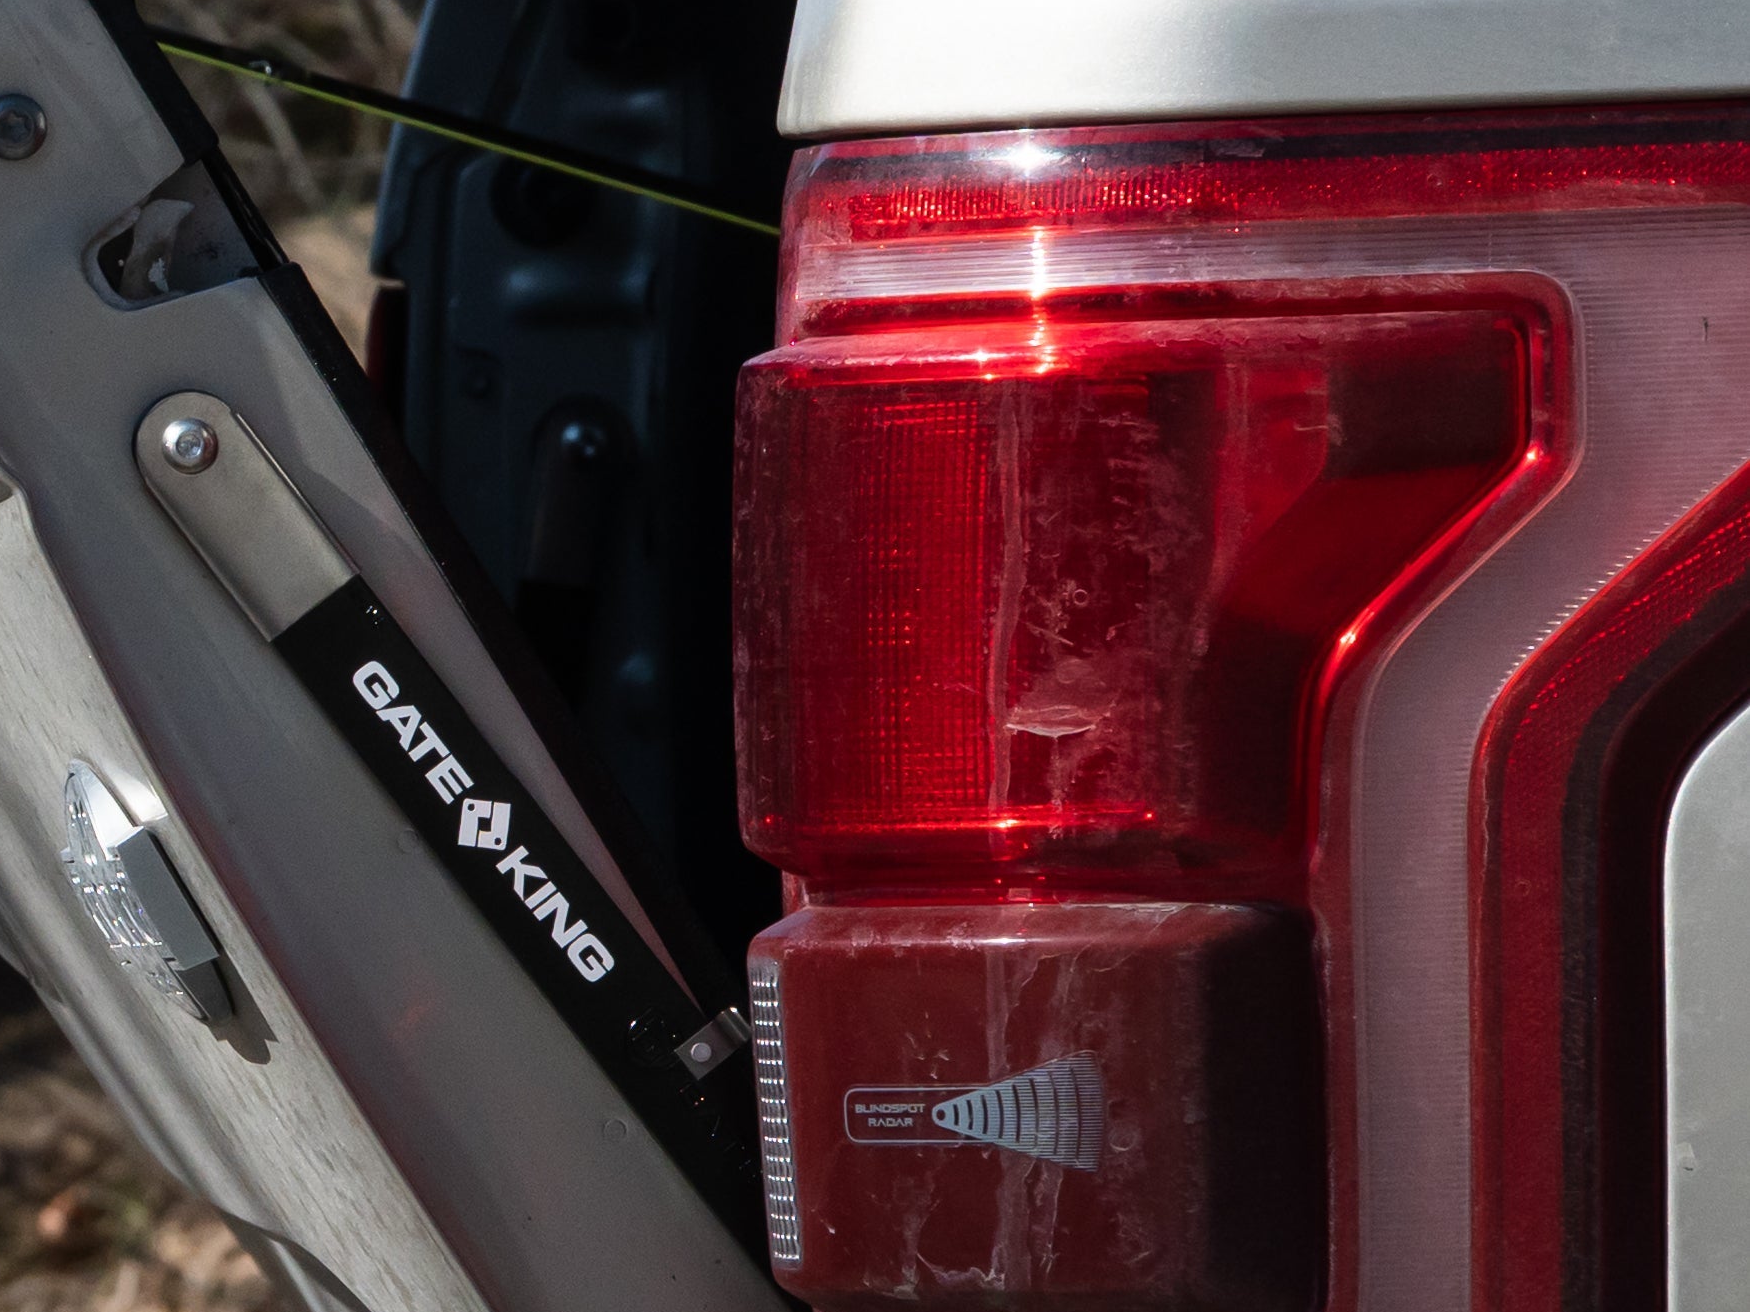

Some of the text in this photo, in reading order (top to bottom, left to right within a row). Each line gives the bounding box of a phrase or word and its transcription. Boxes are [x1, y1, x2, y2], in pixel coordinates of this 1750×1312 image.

[352, 661, 615, 983] GATE KING
[854, 1103, 926, 1113] BLINDSPOT
[867, 1117, 914, 1127] RADAR
